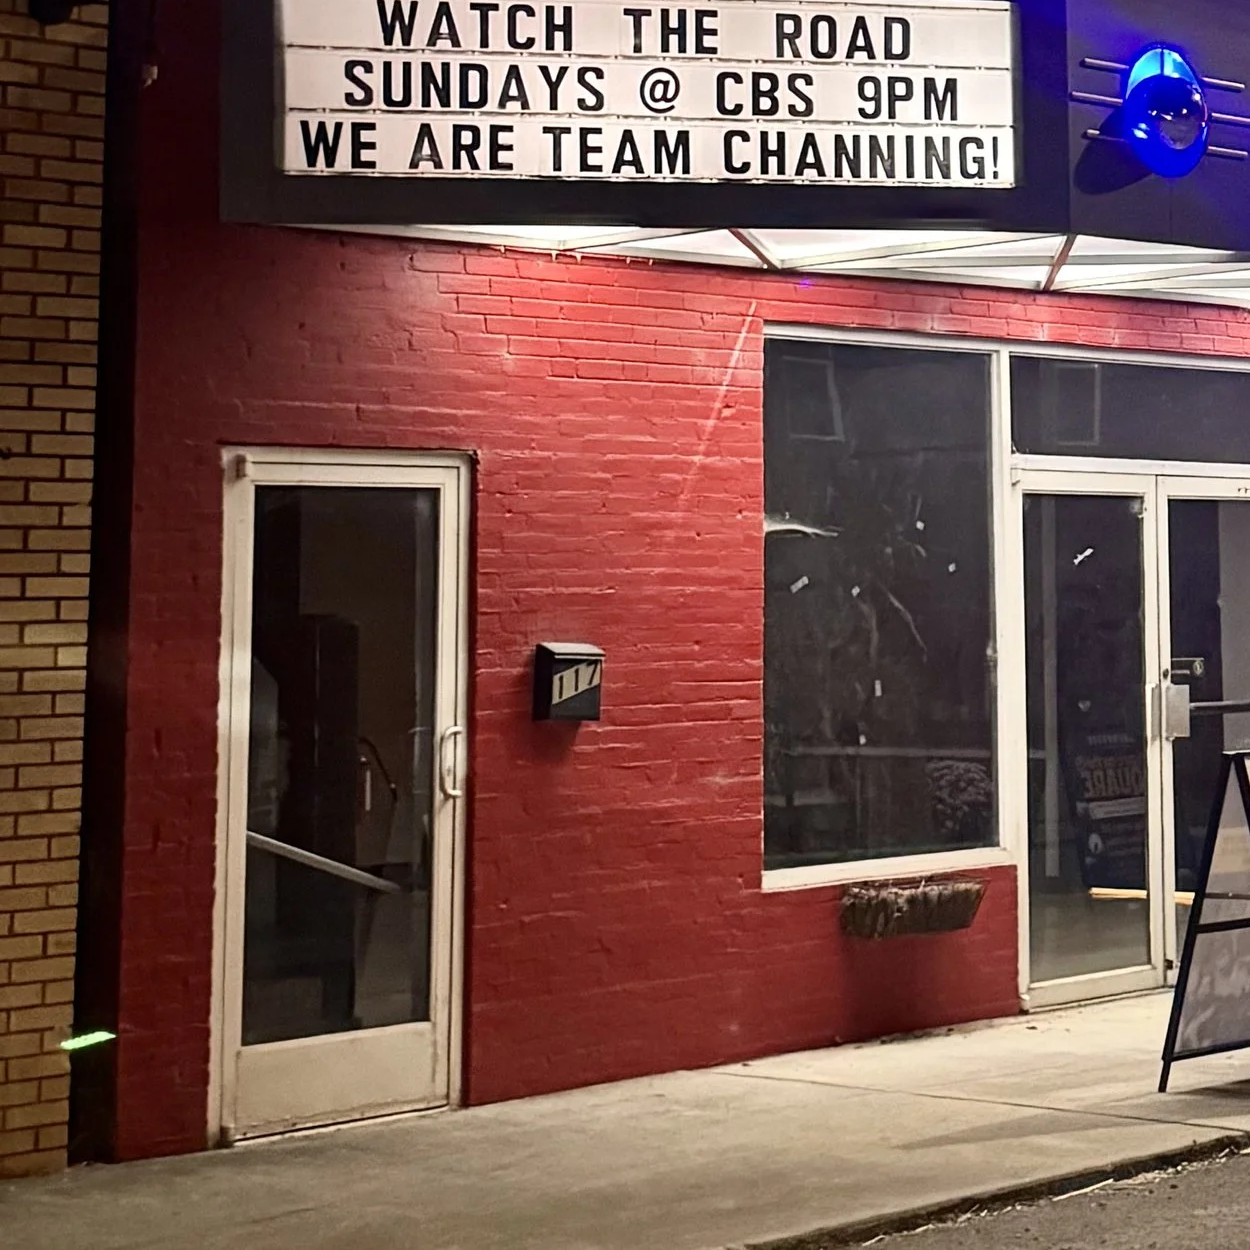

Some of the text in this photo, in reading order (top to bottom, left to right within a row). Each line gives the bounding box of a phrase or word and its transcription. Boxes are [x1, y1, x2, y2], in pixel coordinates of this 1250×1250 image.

[623, 7, 719, 55] THE
[775, 12, 911, 61] ROAD
[344, 59, 958, 121] SUNDAYS @ CBS 9PM
[299, 119, 999, 180] WE ARE TEAM CHANNING!
[558, 660, 599, 700] 117
